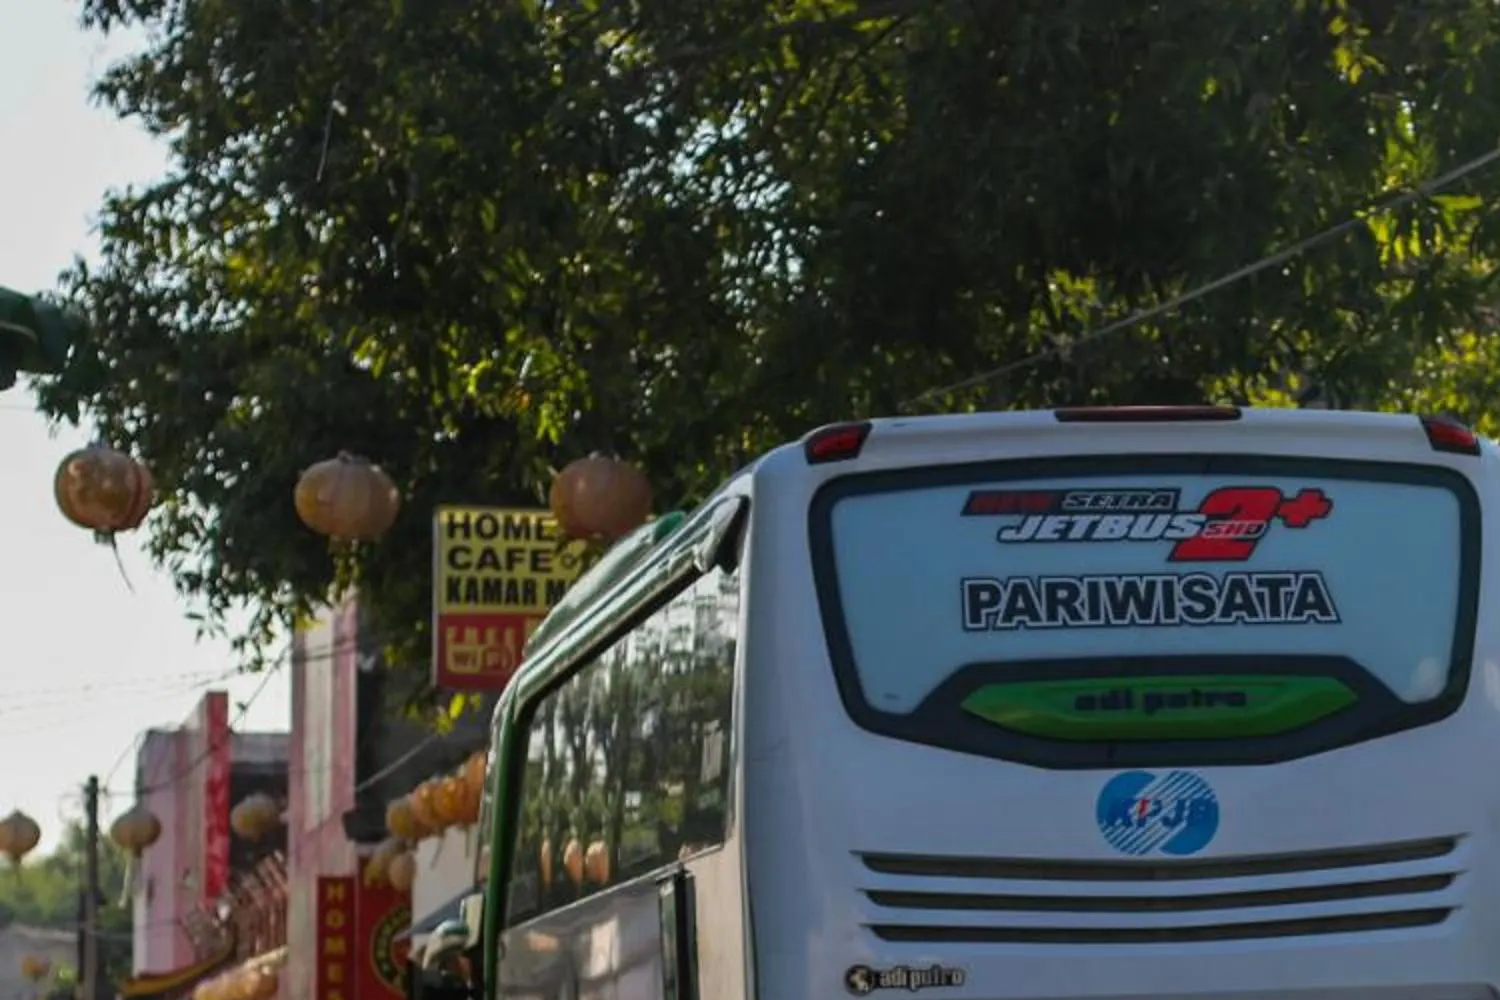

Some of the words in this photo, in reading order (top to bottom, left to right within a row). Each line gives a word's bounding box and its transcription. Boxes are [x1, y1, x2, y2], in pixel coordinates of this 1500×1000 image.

[447, 514, 556, 540] HOME
[998, 513, 1206, 542] JETBUS
[447, 546, 553, 572] CAFE
[446, 577, 537, 605] KAMAR
[961, 571, 1340, 631] PARIWISATA
